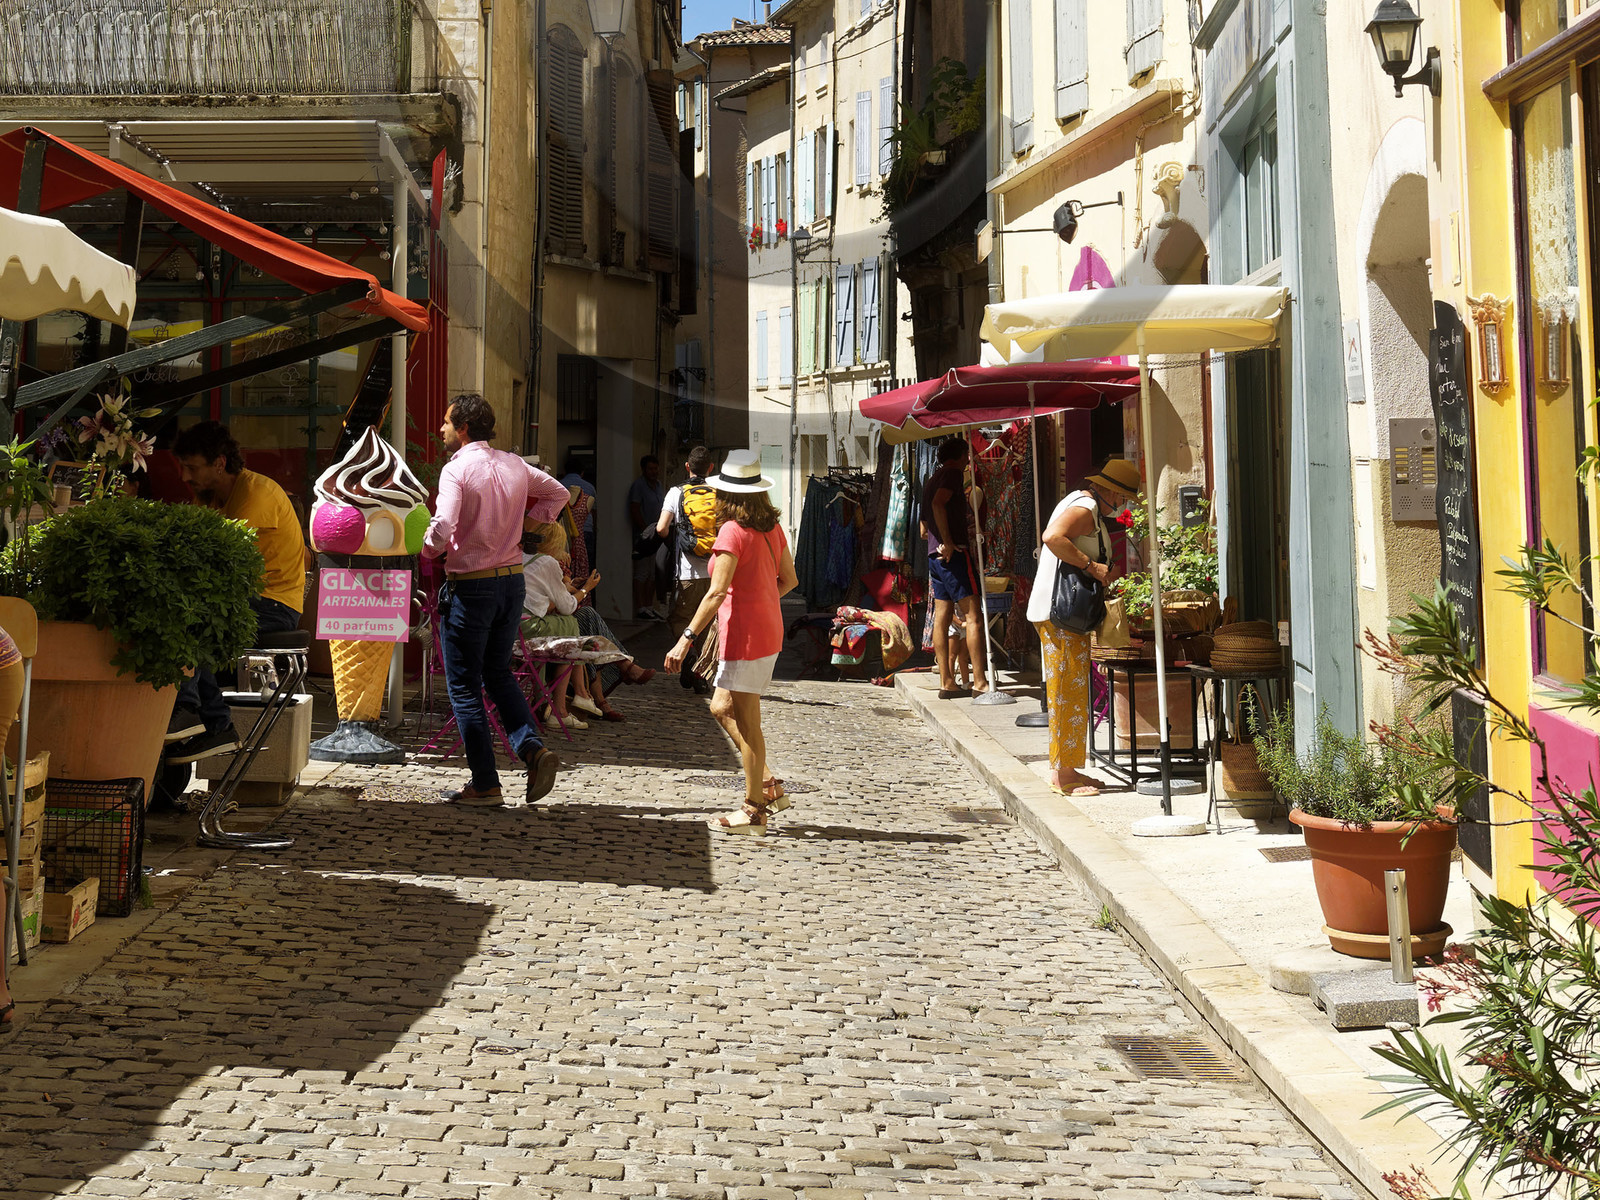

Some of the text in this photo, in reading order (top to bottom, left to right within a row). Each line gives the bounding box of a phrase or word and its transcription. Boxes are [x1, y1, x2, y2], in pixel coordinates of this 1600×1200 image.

[322, 572, 407, 591] GLACES
[322, 595, 405, 608] ARTISANALES
[325, 620, 394, 632] 40 parfums
